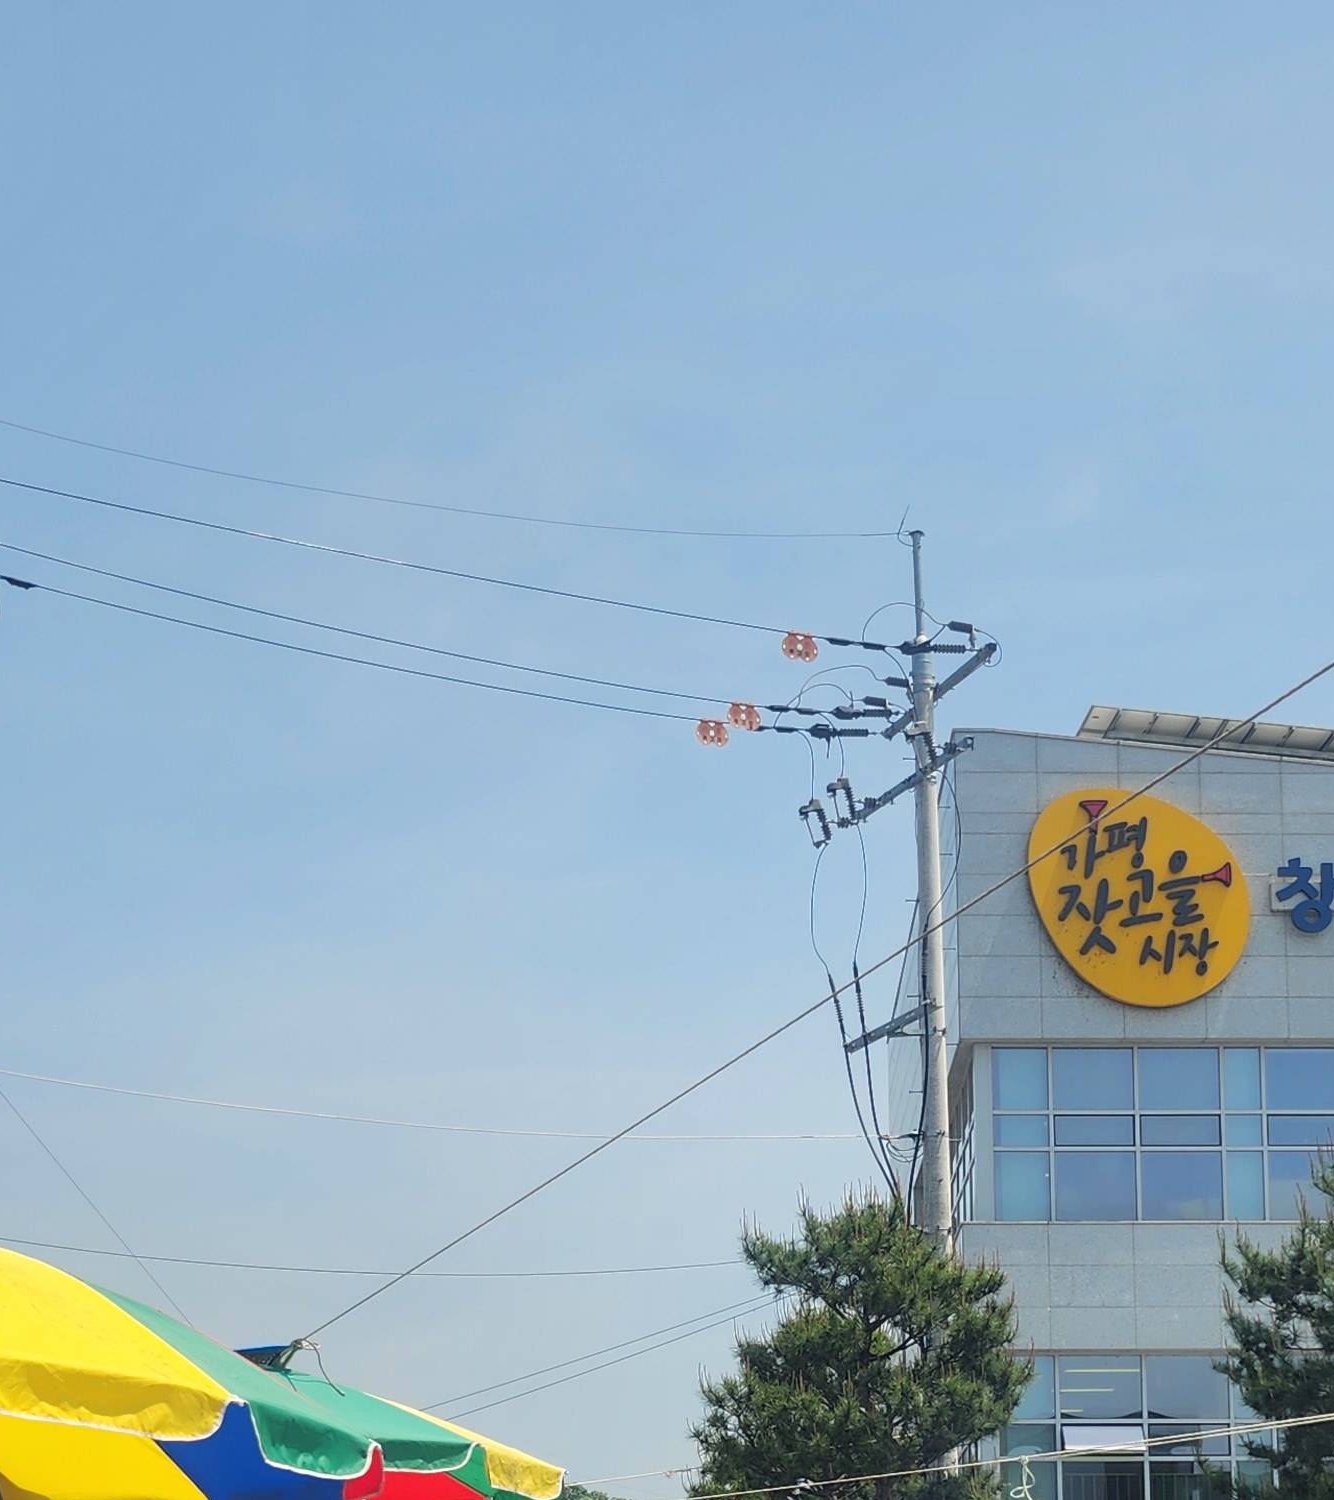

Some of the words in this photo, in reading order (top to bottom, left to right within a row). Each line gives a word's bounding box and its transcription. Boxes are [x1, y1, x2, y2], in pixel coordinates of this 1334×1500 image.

[1060, 816, 1148, 878] 가평
[1058, 851, 1207, 955] 잣고을
[1139, 927, 1219, 975] 시장
